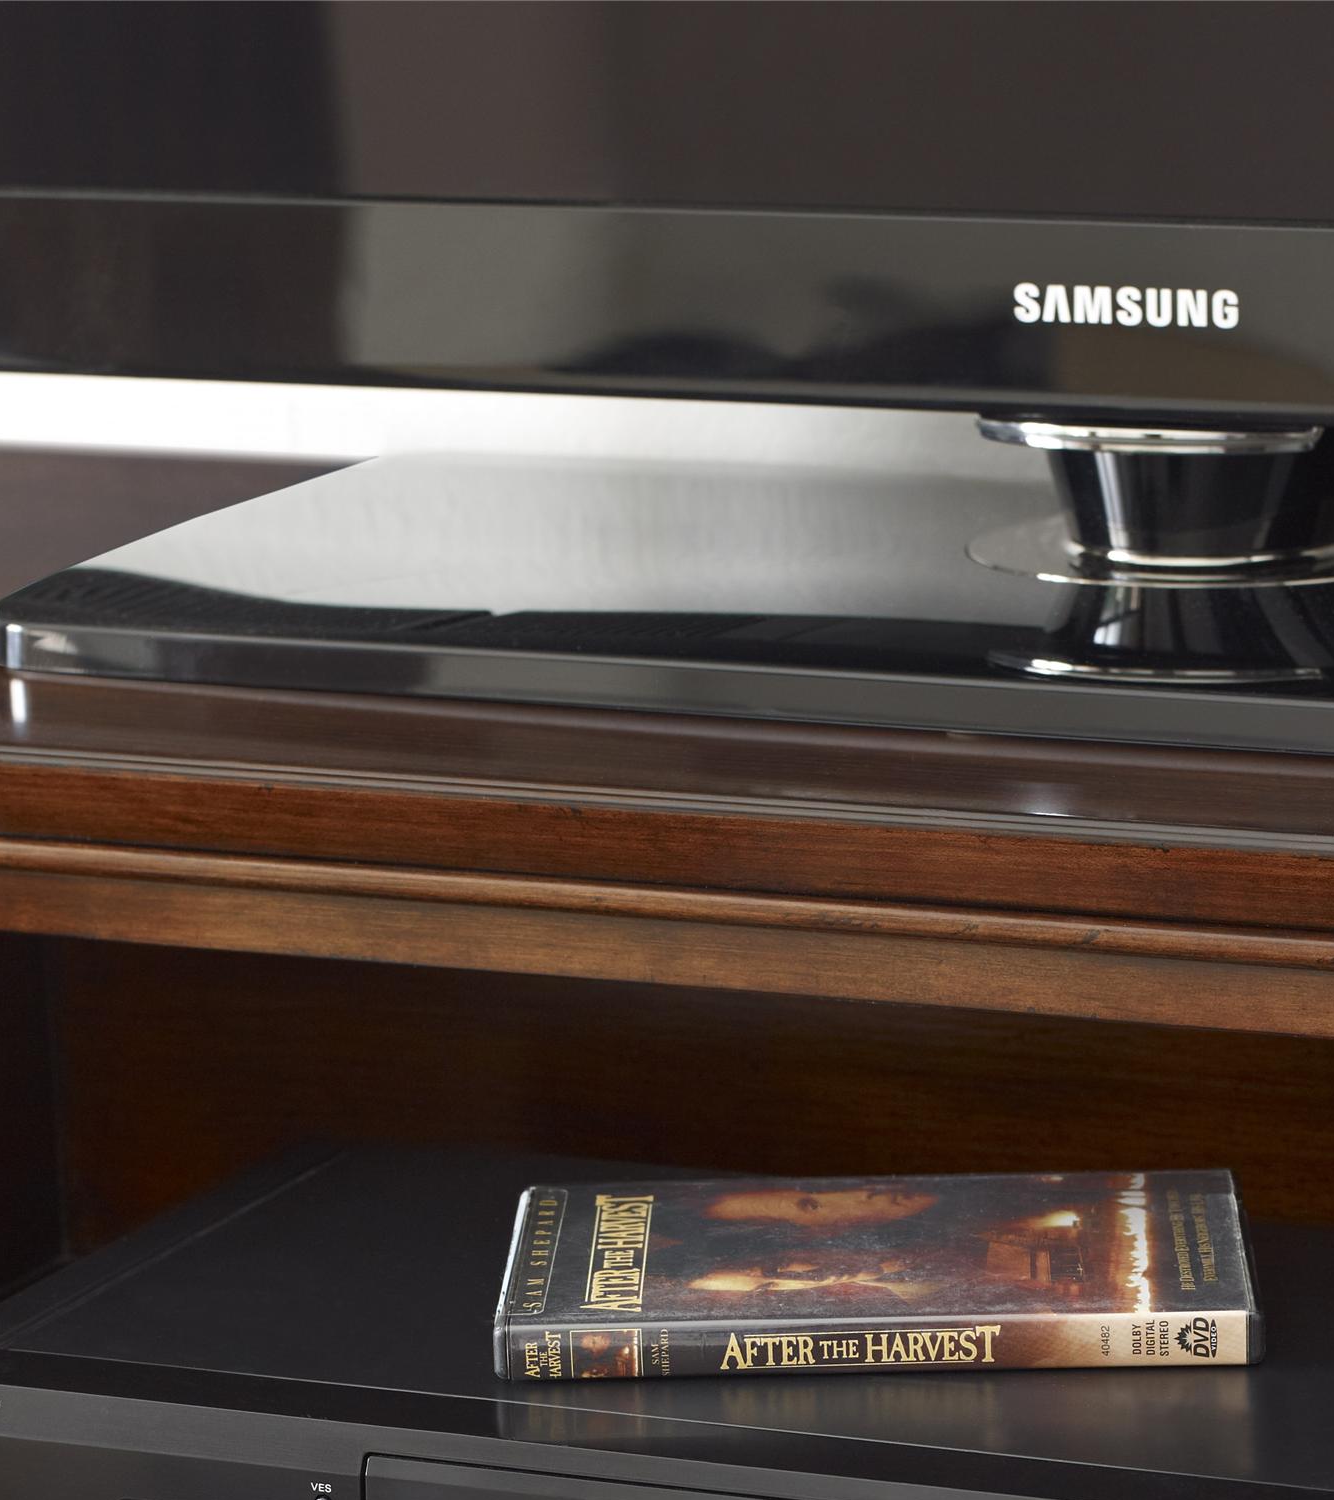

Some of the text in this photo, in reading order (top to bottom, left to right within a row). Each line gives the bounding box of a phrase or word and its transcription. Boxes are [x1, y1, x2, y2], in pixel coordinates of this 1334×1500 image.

[1012, 282, 1240, 330] SAMSUNG
[522, 1199, 558, 1311] SAM SHEPARD
[579, 1194, 654, 1312] AFTER THE HARVEST
[651, 1342, 660, 1365] SAM
[720, 1324, 1001, 1370] AFTER THE HARVEST
[1100, 1325, 1111, 1357] 40482
[1132, 1323, 1142, 1355] DOLBY
[1145, 1319, 1156, 1356] DIGITAL
[1159, 1320, 1170, 1357] STEREO
[1192, 1317, 1210, 1358] DVD
[524, 1341, 541, 1379] AFTER
[540, 1352, 548, 1368] THE
[310, 1482, 332, 1493] VES
